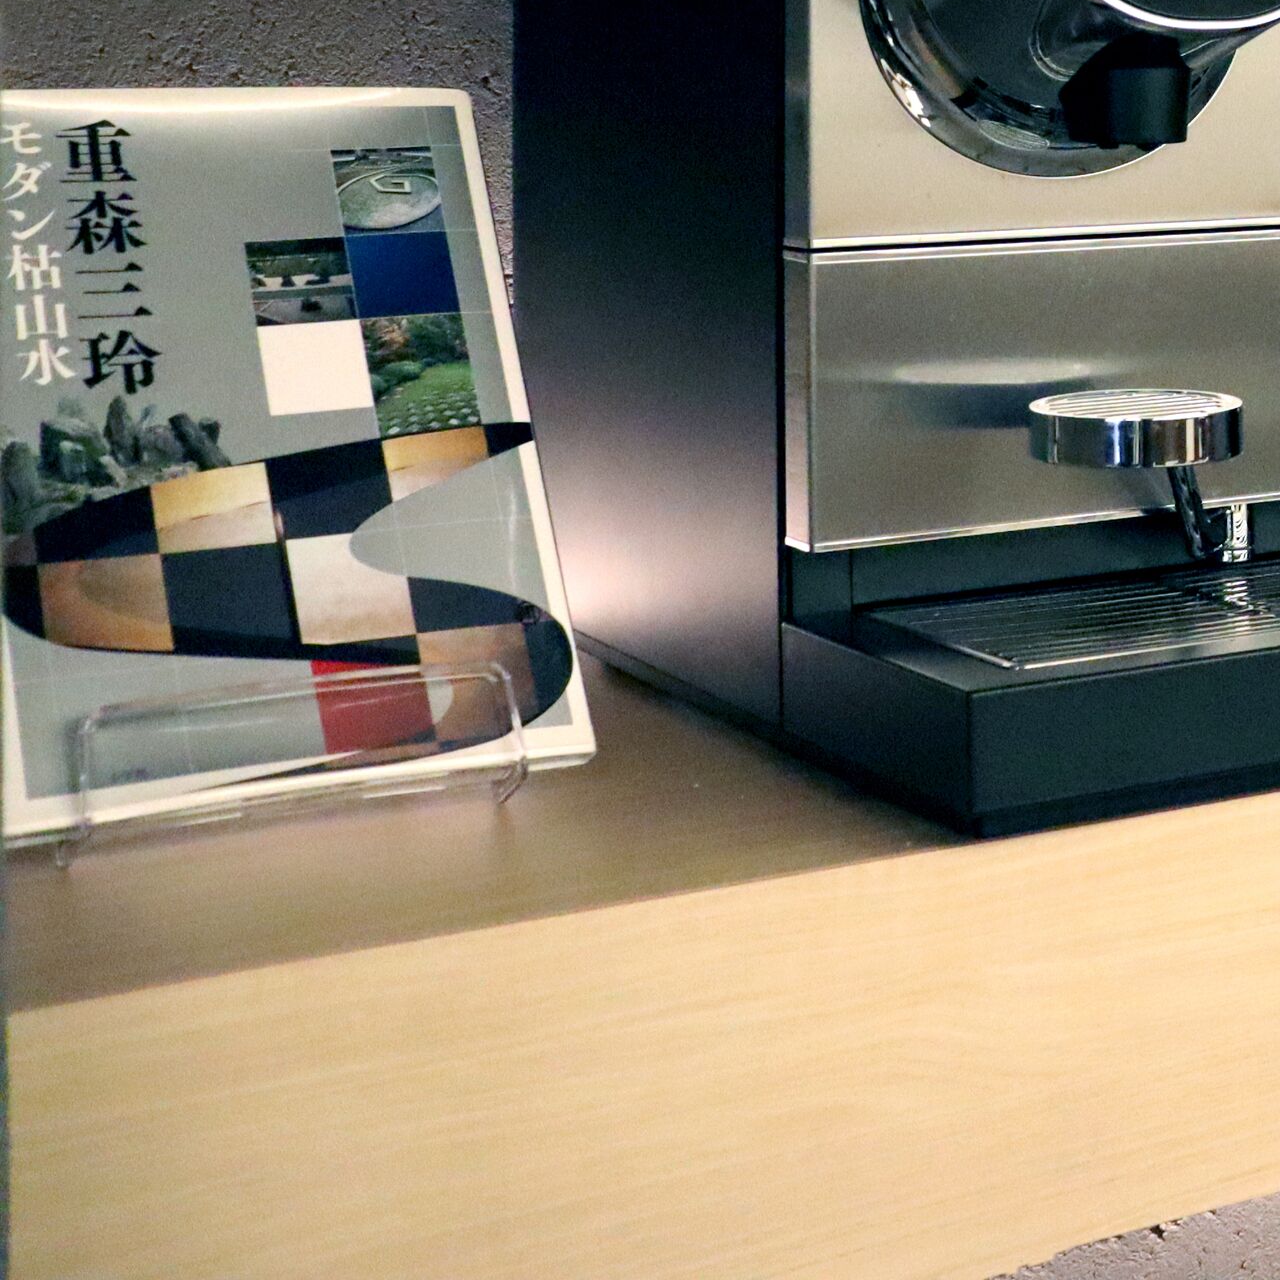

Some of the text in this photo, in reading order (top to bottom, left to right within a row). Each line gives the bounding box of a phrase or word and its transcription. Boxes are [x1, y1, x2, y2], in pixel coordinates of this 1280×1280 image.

[0, 121, 77, 386] モダン枯山水
[55, 119, 163, 395] 重森三玲
